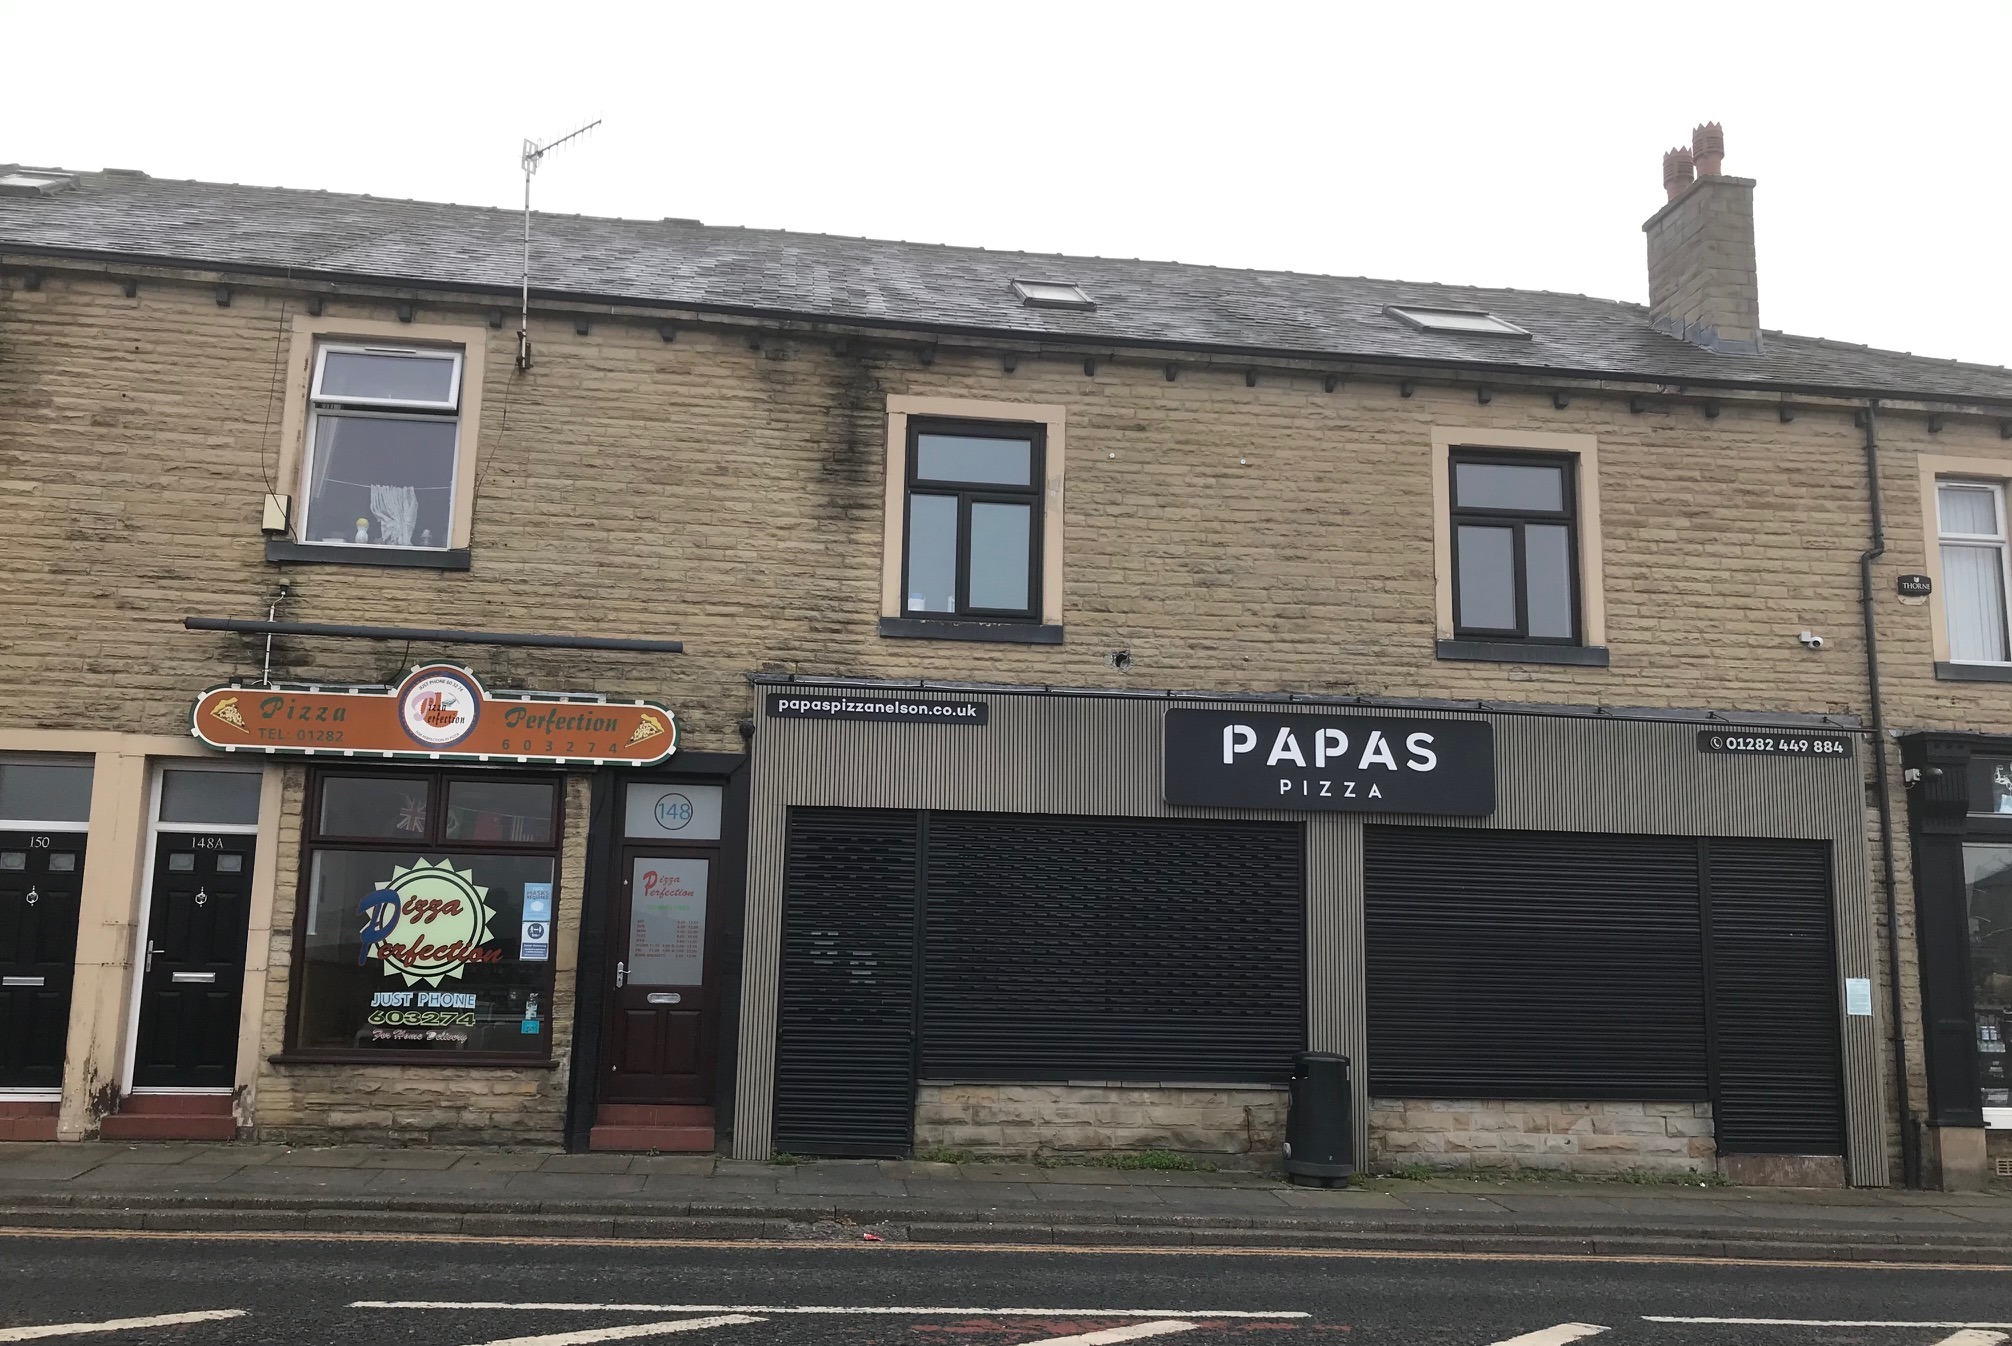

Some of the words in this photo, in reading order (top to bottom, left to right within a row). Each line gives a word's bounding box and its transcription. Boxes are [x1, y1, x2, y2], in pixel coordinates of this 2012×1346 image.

[260, 695, 347, 722] Pizza
[778, 698, 977, 718] papaspizzanelson.co.uk
[504, 706, 619, 735] Perfection
[296, 729, 344, 742] 01282
[1222, 723, 1438, 773] PAPAS
[1725, 737, 1774, 751] 01282
[1778, 739, 1808, 752] 449
[1813, 740, 1844, 754] 884
[1280, 778, 1382, 799] PIZZA
[658, 803, 690, 820] 148
[29, 836, 50, 848] 150
[191, 836, 224, 849] 148A
[370, 992, 414, 1007] JUST
[418, 992, 477, 1009] PHONE
[367, 1009, 476, 1027] 603274
[372, 1028, 391, 1041] For
[393, 1028, 423, 1040] Home
[425, 1029, 468, 1044] Delivery
